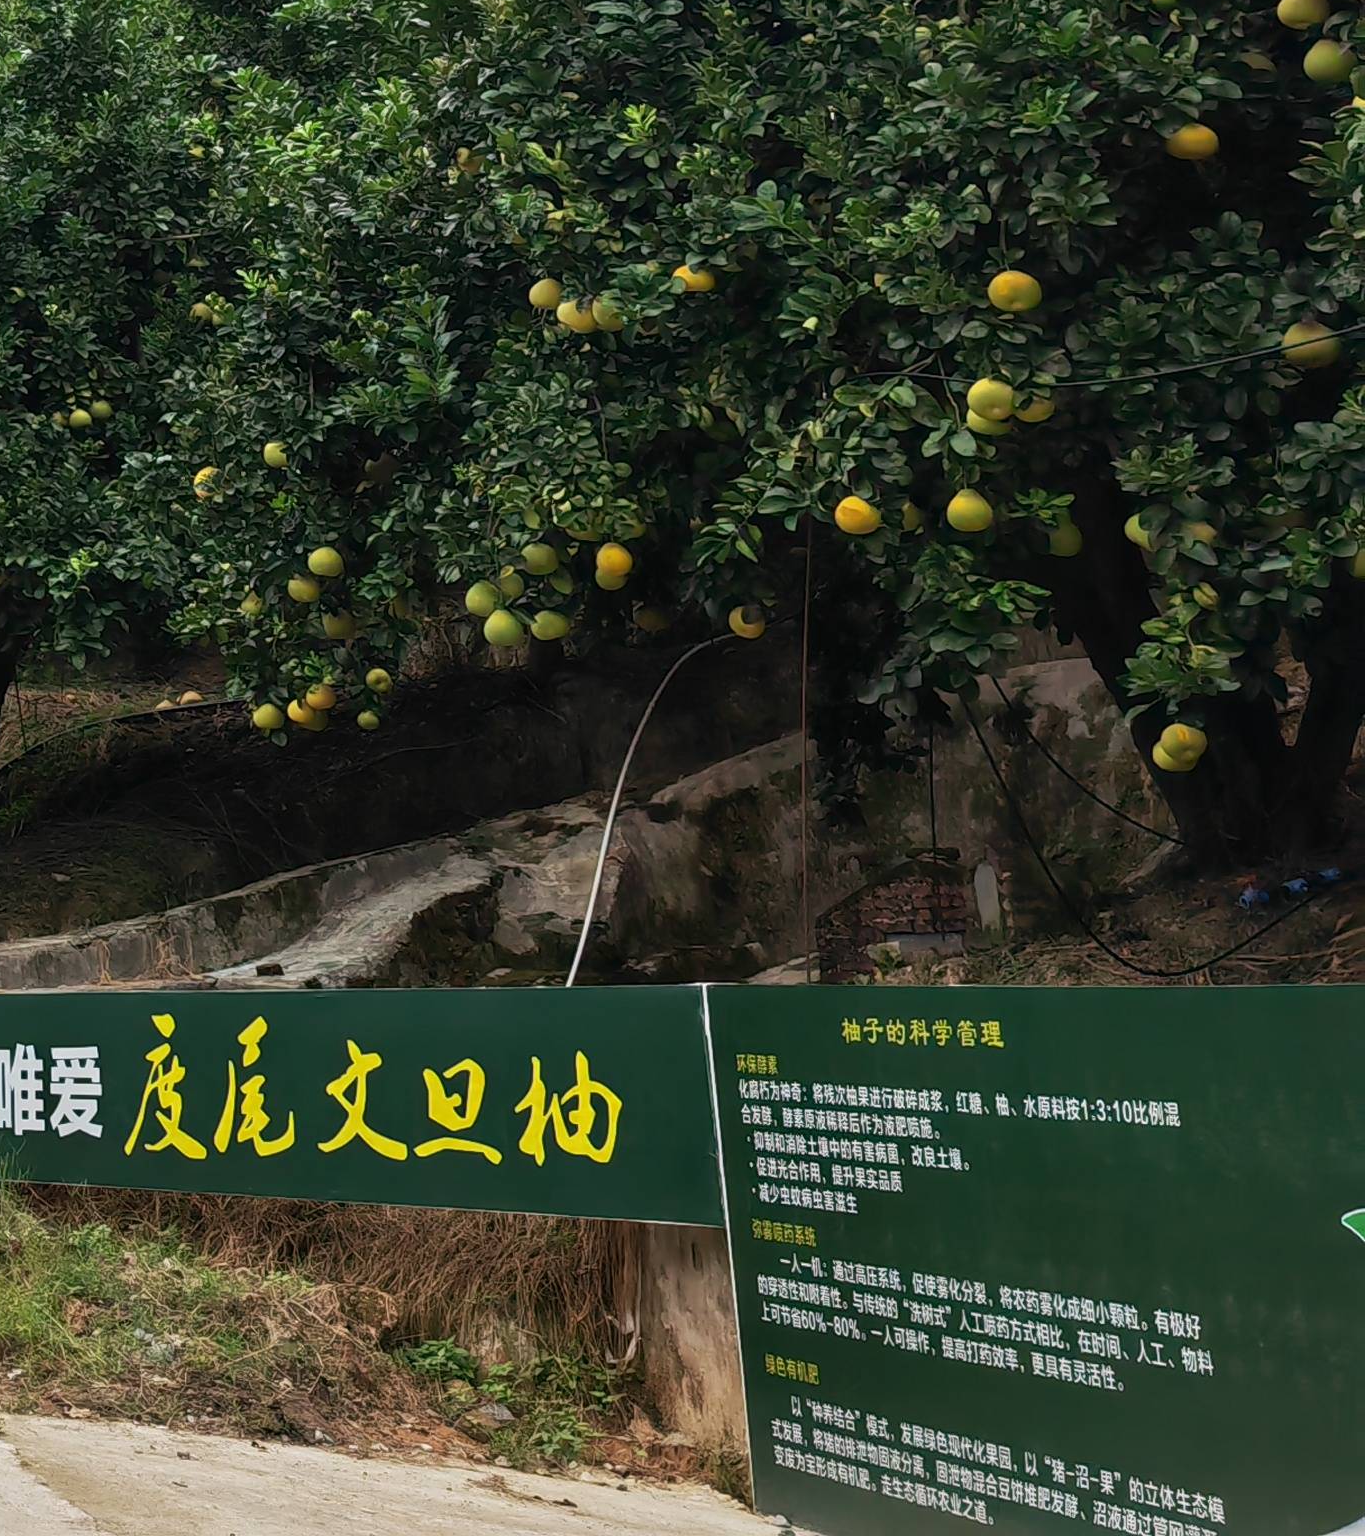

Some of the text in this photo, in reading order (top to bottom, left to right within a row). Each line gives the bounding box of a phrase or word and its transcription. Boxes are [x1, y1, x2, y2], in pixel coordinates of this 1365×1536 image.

[841, 1018, 1005, 1048] 柚子的科学管理
[736, 1054, 778, 1075] 环保酵素
[765, 1353, 820, 1385] 绿色有机肥
